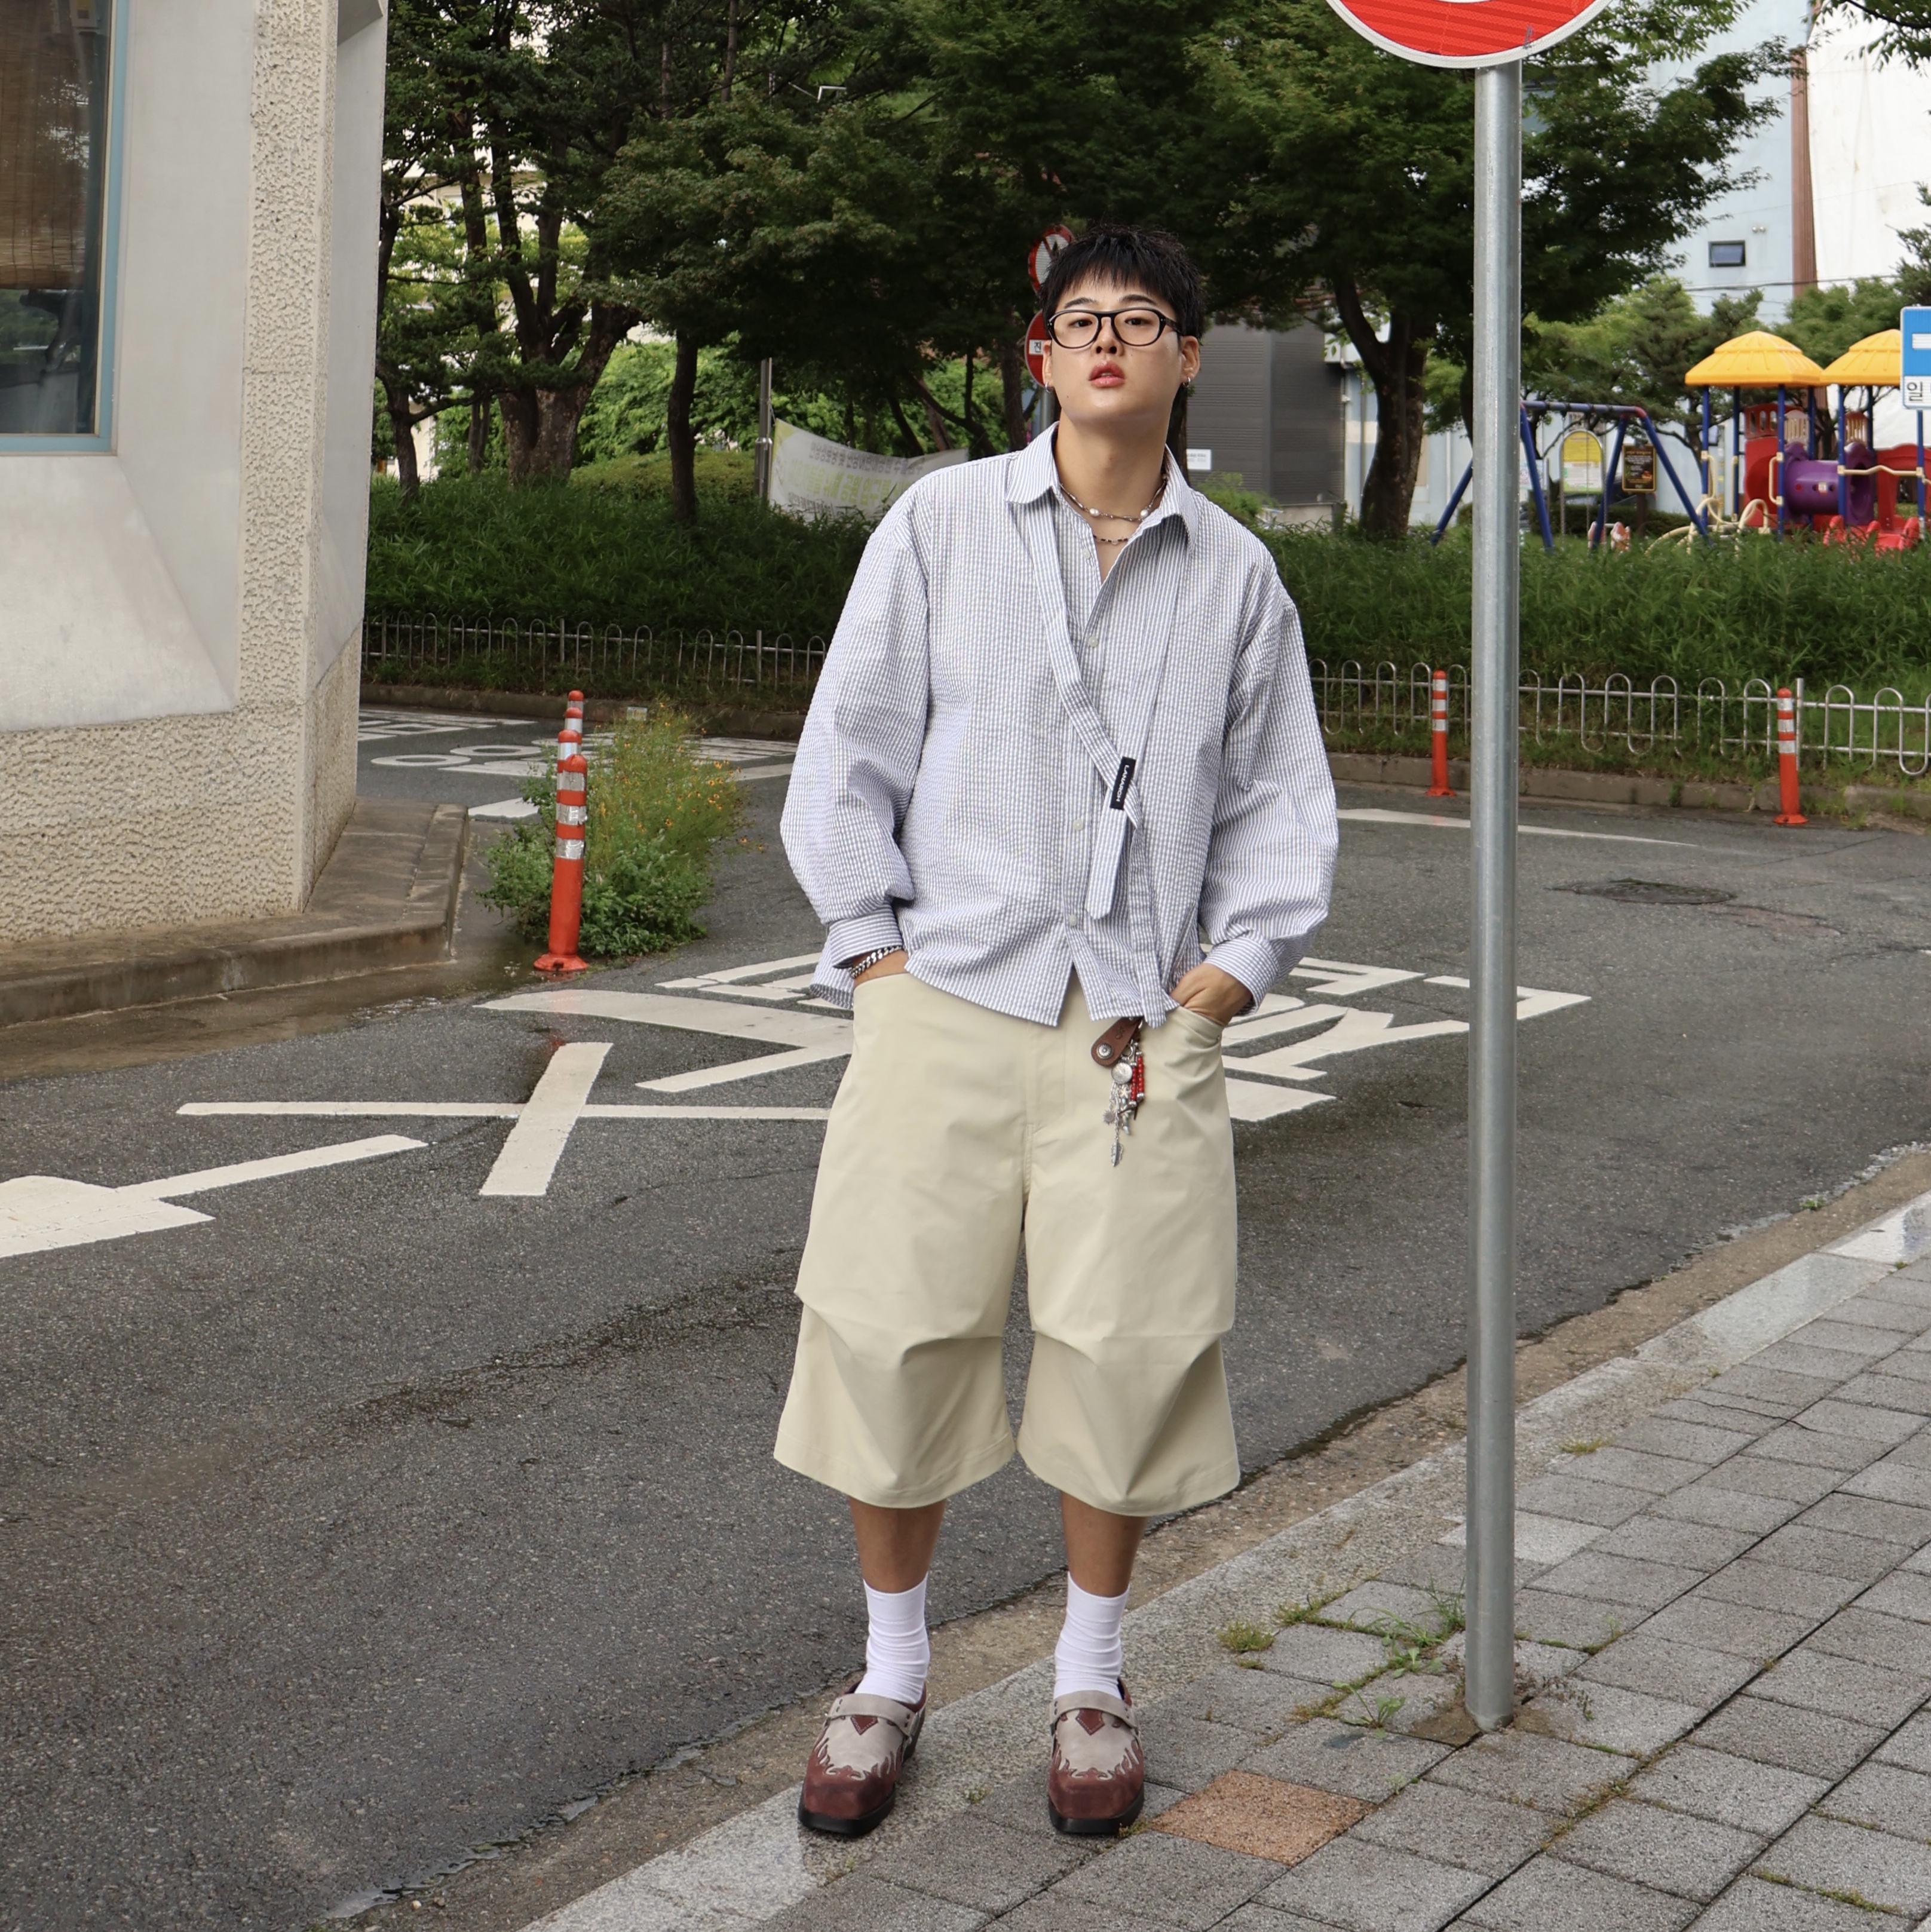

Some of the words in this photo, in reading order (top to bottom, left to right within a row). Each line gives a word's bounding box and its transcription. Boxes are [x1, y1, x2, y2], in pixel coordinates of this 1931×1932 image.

[1034, 341, 1042, 353] 진
[1907, 381, 1931, 401] 일
[1116, 764, 1130, 802] LANARCH
